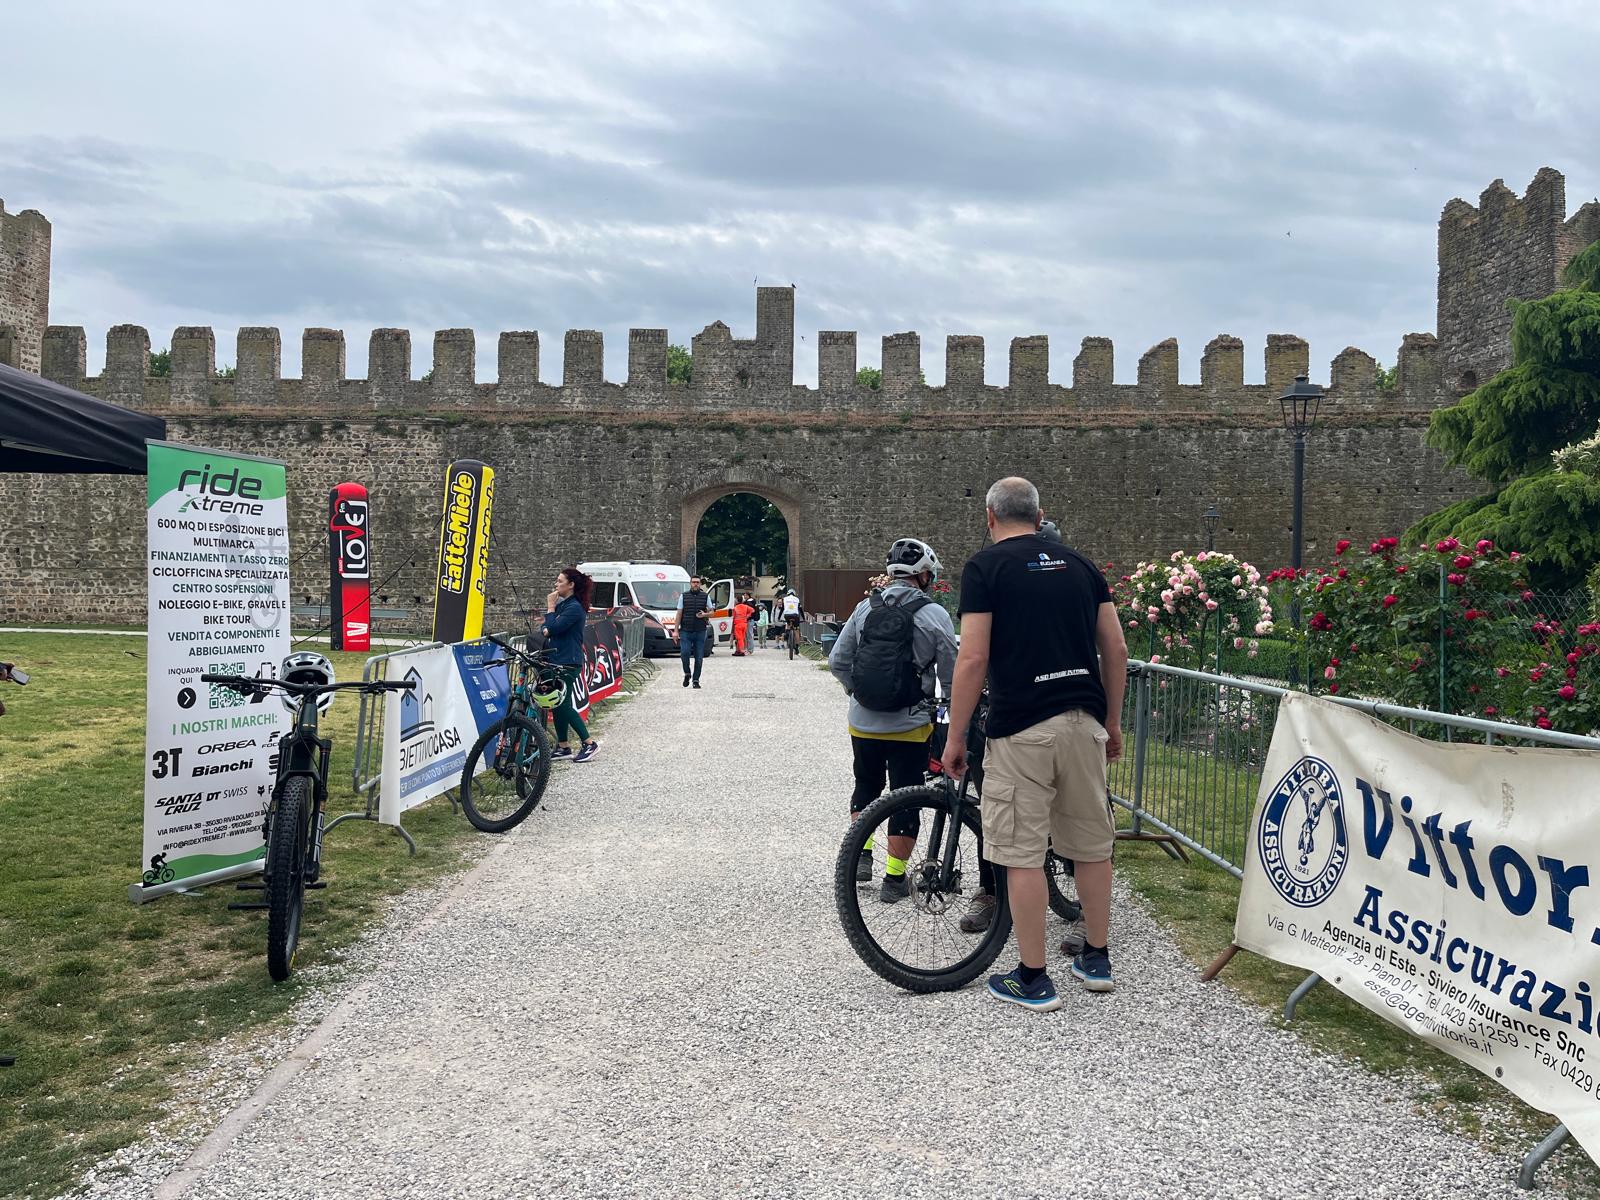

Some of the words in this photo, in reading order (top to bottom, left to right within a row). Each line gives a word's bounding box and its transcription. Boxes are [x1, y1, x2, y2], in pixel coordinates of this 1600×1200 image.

[177, 464, 262, 500] ride
[157, 519, 176, 529] 600
[179, 521, 195, 531] MQ
[198, 522, 206, 532] DI
[209, 523, 266, 535] ESPOSIZIONE
[268, 528, 284, 536] BICI
[442, 473, 475, 592] LatteMiele
[194, 538, 254, 549] MULTIMARCA
[345, 512, 366, 569] LOVE
[151, 551, 228, 563] FINANZIAMENTI
[230, 554, 236, 563] A
[238, 555, 266, 564] TASSO
[268, 556, 288, 566] ZERO
[152, 567, 222, 578] CICLOFFICINA
[224, 570, 288, 580] SPECIALIZZATA
[172, 584, 212, 593] CENTRO
[214, 584, 273, 594] SOSPENSIONI
[158, 600, 210, 610] NOLEGGIO
[213, 600, 246, 610] E-BIKE,
[248, 600, 280, 608] GRAVEL
[282, 600, 286, 608] E
[204, 616, 224, 624] BIKE
[226, 616, 250, 624] TOUR
[168, 632, 212, 641] VENDITA
[214, 630, 274, 640] COMPONENTI
[276, 630, 280, 638] E
[188, 644, 264, 656] ABBIGLIAMENTO
[168, 666, 204, 674] INQUADRA
[172, 724, 176, 736] I
[181, 718, 228, 734] NOSTRI
[232, 713, 278, 729] MARCHI:
[197, 739, 256, 755] ORBEA
[152, 748, 182, 780] 3T
[192, 759, 254, 778] Bianchi
[154, 792, 204, 808] SANTA
[206, 791, 222, 801] DT
[223, 786, 248, 798] SWISS
[164, 802, 202, 816] CRUZ
[157, 828, 170, 836] VIA
[169, 824, 192, 834] RIVIERA
[1264, 820, 1345, 902] ASSICURAZIONI
[1355, 777, 1600, 946] Vittor
[1294, 864, 1310, 876] 1921
[1353, 884, 1600, 1040] Assicurazi
[1322, 920, 1371, 954] Agenzia
[1375, 944, 1386, 961] di
[1389, 950, 1417, 976] Este
[1428, 970, 1467, 1004] Siviero
[1467, 994, 1550, 1042] Insurance
[1556, 1030, 1585, 1062] Snc
[1267, 913, 1284, 932] Via
[1287, 923, 1298, 938] G.
[1346, 952, 1365, 966] 28
[1368, 962, 1401, 987] Piano
[1400, 981, 1418, 994] 01
[1428, 990, 1440, 1013] Tel.
[1440, 1002, 1466, 1027] 0429
[1468, 1017, 1519, 1048] 51259
[1534, 1042, 1558, 1071] Fax
[1560, 1060, 1593, 1093] 0429
[1363, 979, 1494, 1057] este@agentivittoria.it
